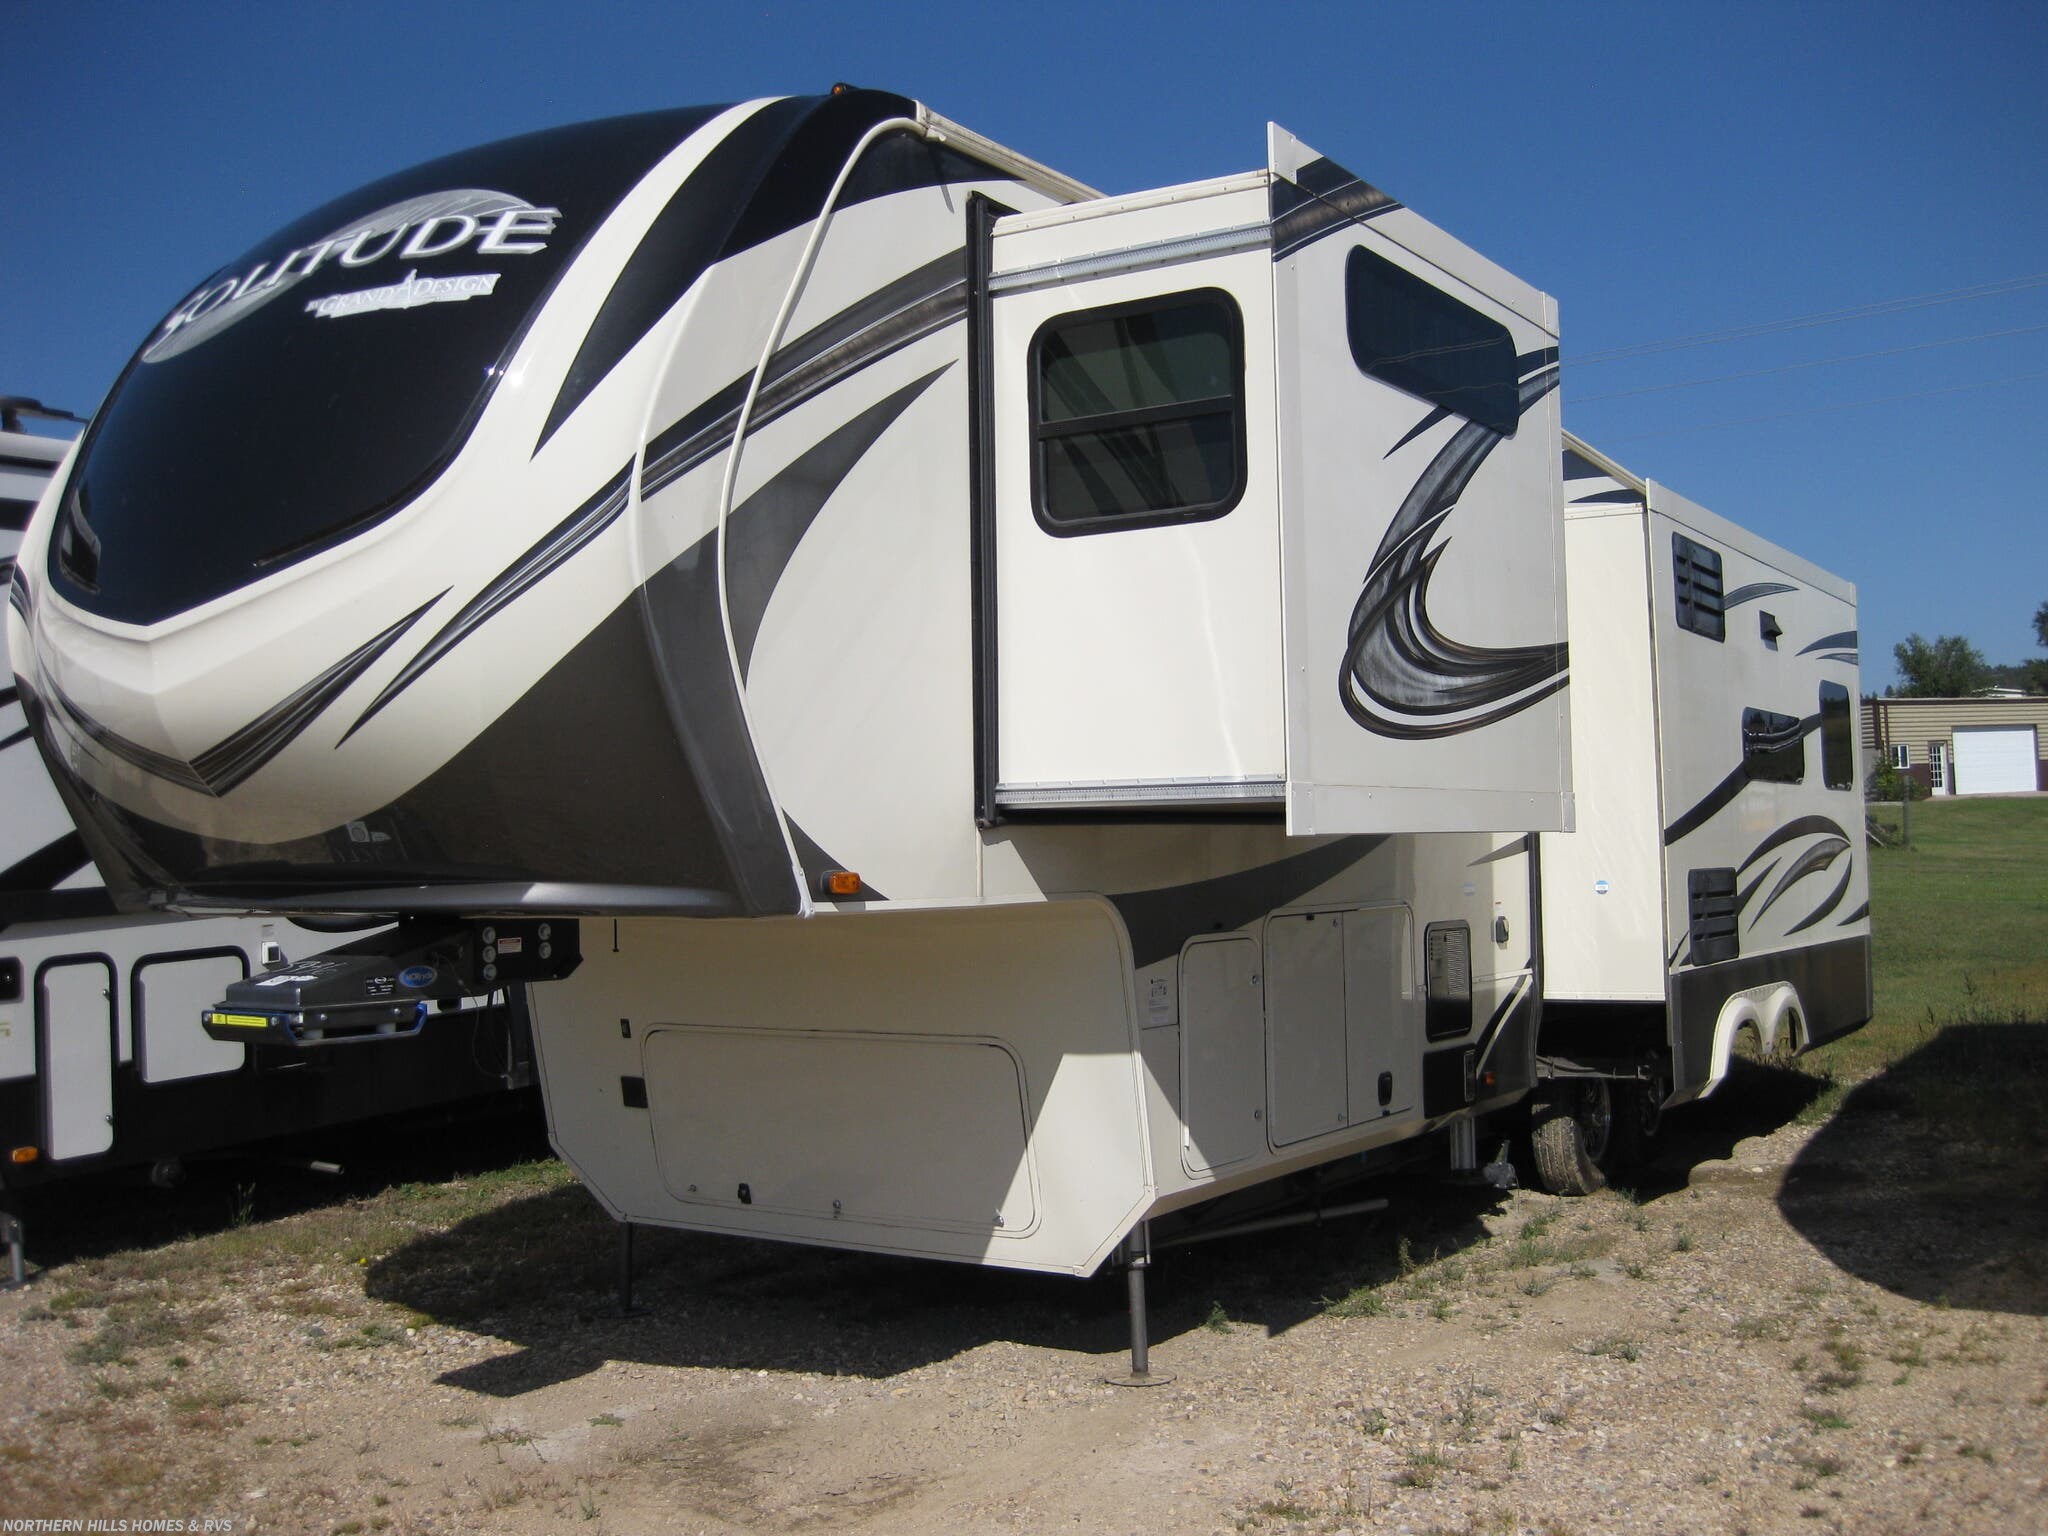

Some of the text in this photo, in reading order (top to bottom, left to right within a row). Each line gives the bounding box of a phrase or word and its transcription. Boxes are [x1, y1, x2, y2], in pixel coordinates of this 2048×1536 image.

[164, 207, 563, 333] SOLITUDE
[319, 287, 395, 313] GRAND
[414, 276, 496, 298] DESIGN
